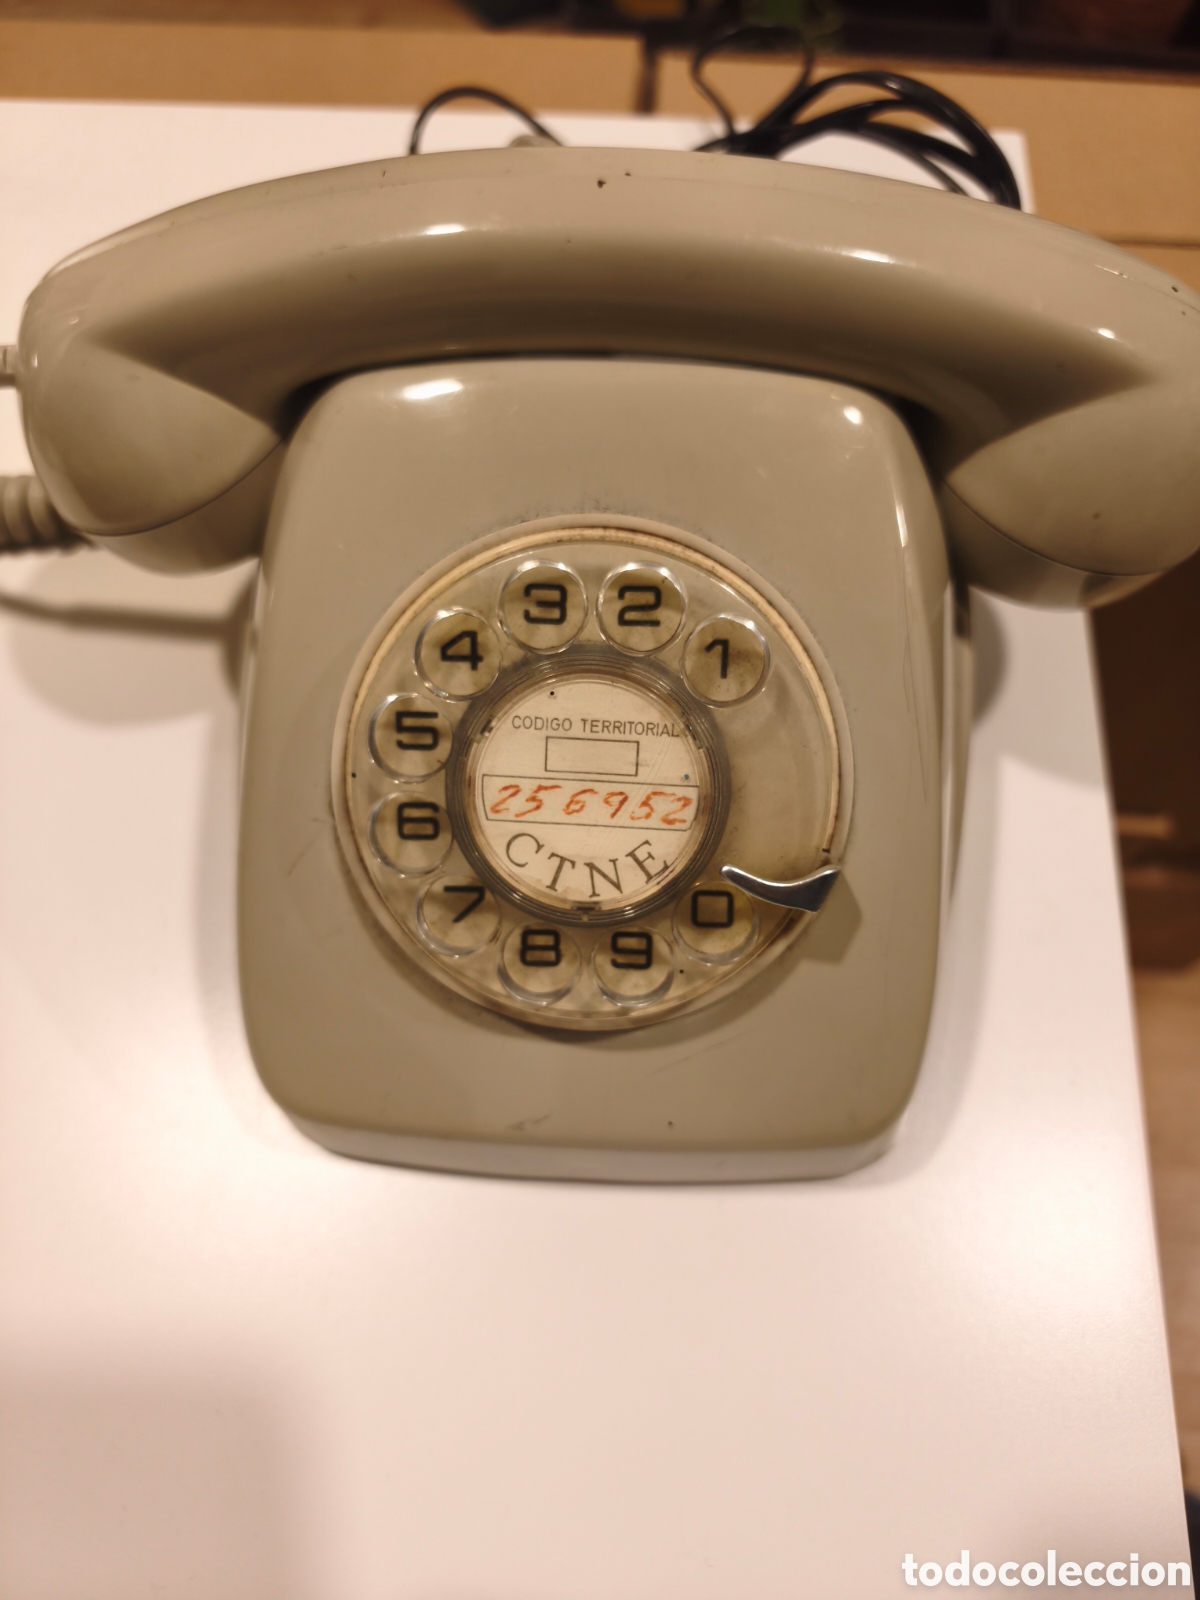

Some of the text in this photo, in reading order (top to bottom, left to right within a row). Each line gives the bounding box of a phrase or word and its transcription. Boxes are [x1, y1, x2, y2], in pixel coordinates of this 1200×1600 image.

[523, 583, 568, 625] 3
[617, 585, 662, 627] 2
[440, 630, 483, 671] 4
[704, 639, 729, 679] 1
[395, 711, 439, 750] 5
[511, 715, 681, 738] CODIGO TERRITORIAL
[398, 801, 440, 841] 6
[505, 832, 670, 898] CTNE
[443, 885, 486, 923] 7
[519, 929, 562, 967] 8
[610, 931, 653, 969] 9
